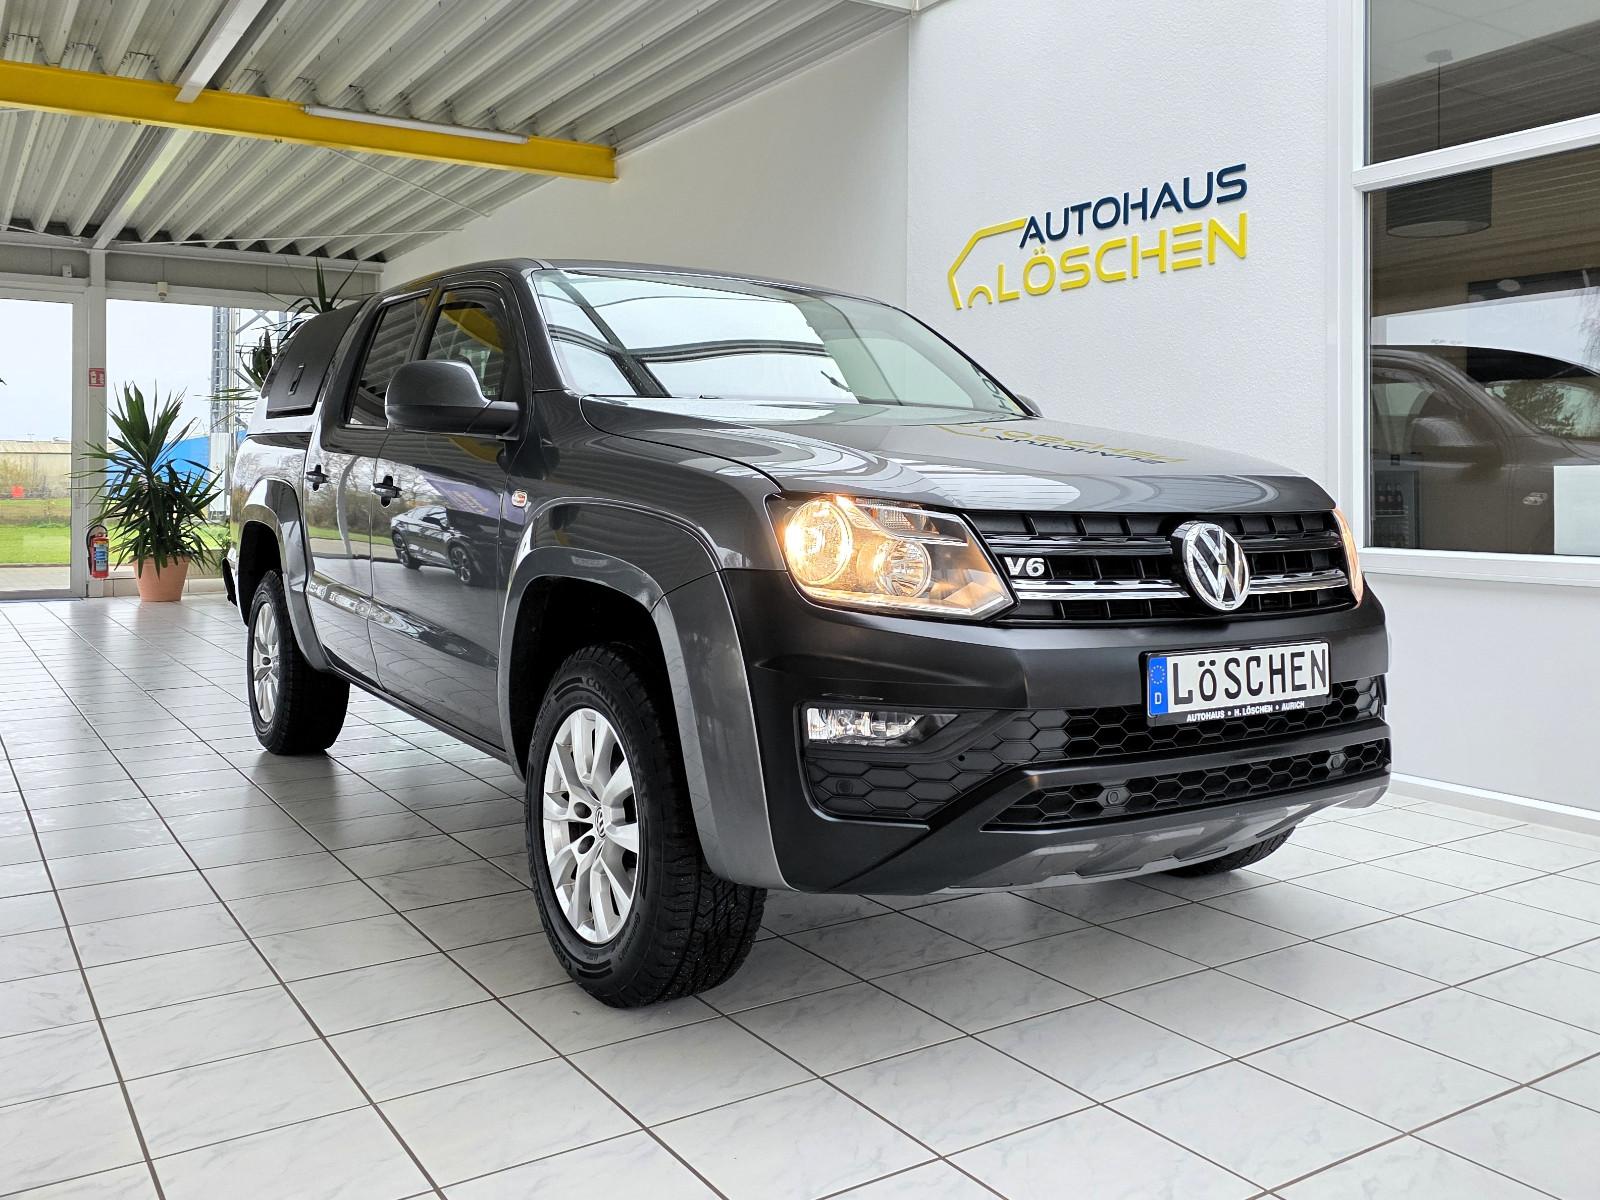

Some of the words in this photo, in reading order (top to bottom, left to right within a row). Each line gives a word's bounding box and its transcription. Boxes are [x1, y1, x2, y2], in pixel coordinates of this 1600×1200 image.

[1018, 163, 1249, 249] AUTOHAUS
[997, 211, 1248, 304] LÖSCHEN
[1004, 556, 1045, 578] V6
[1172, 648, 1327, 706] LÖSCHEN
[1154, 692, 1162, 705] D
[1186, 710, 1225, 722] AUTOHAUS
[1242, 704, 1273, 716] LÖSCHEN
[1281, 701, 1305, 711] AURICH
